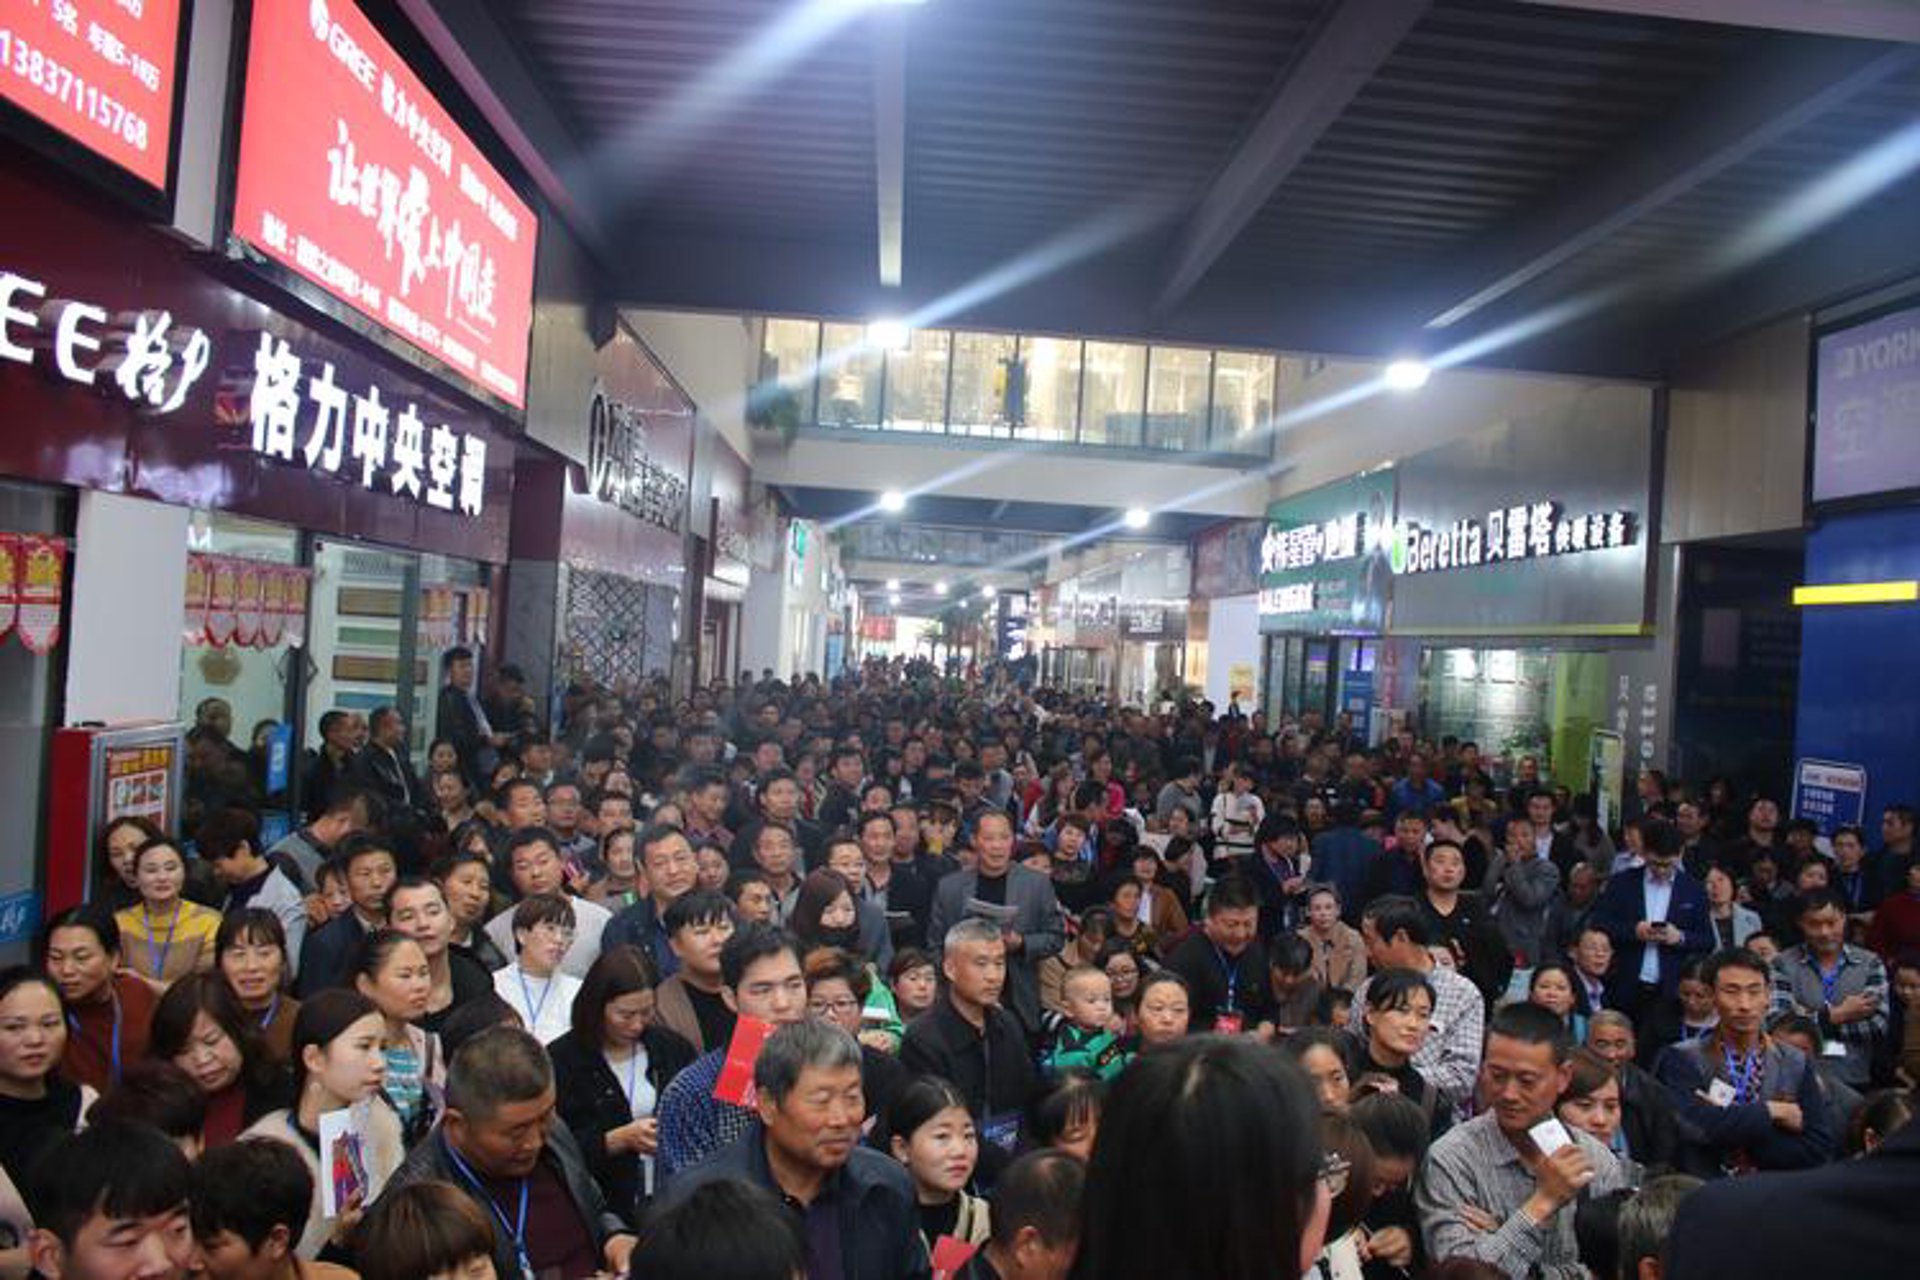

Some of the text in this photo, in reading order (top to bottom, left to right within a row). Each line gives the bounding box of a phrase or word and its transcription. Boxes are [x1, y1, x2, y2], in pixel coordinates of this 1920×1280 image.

[329, 22, 378, 92] GREE
[250, 331, 487, 516] 格力中央空调
[1408, 519, 1480, 574] Beretta
[1487, 501, 1554, 561] 贝雷塔
